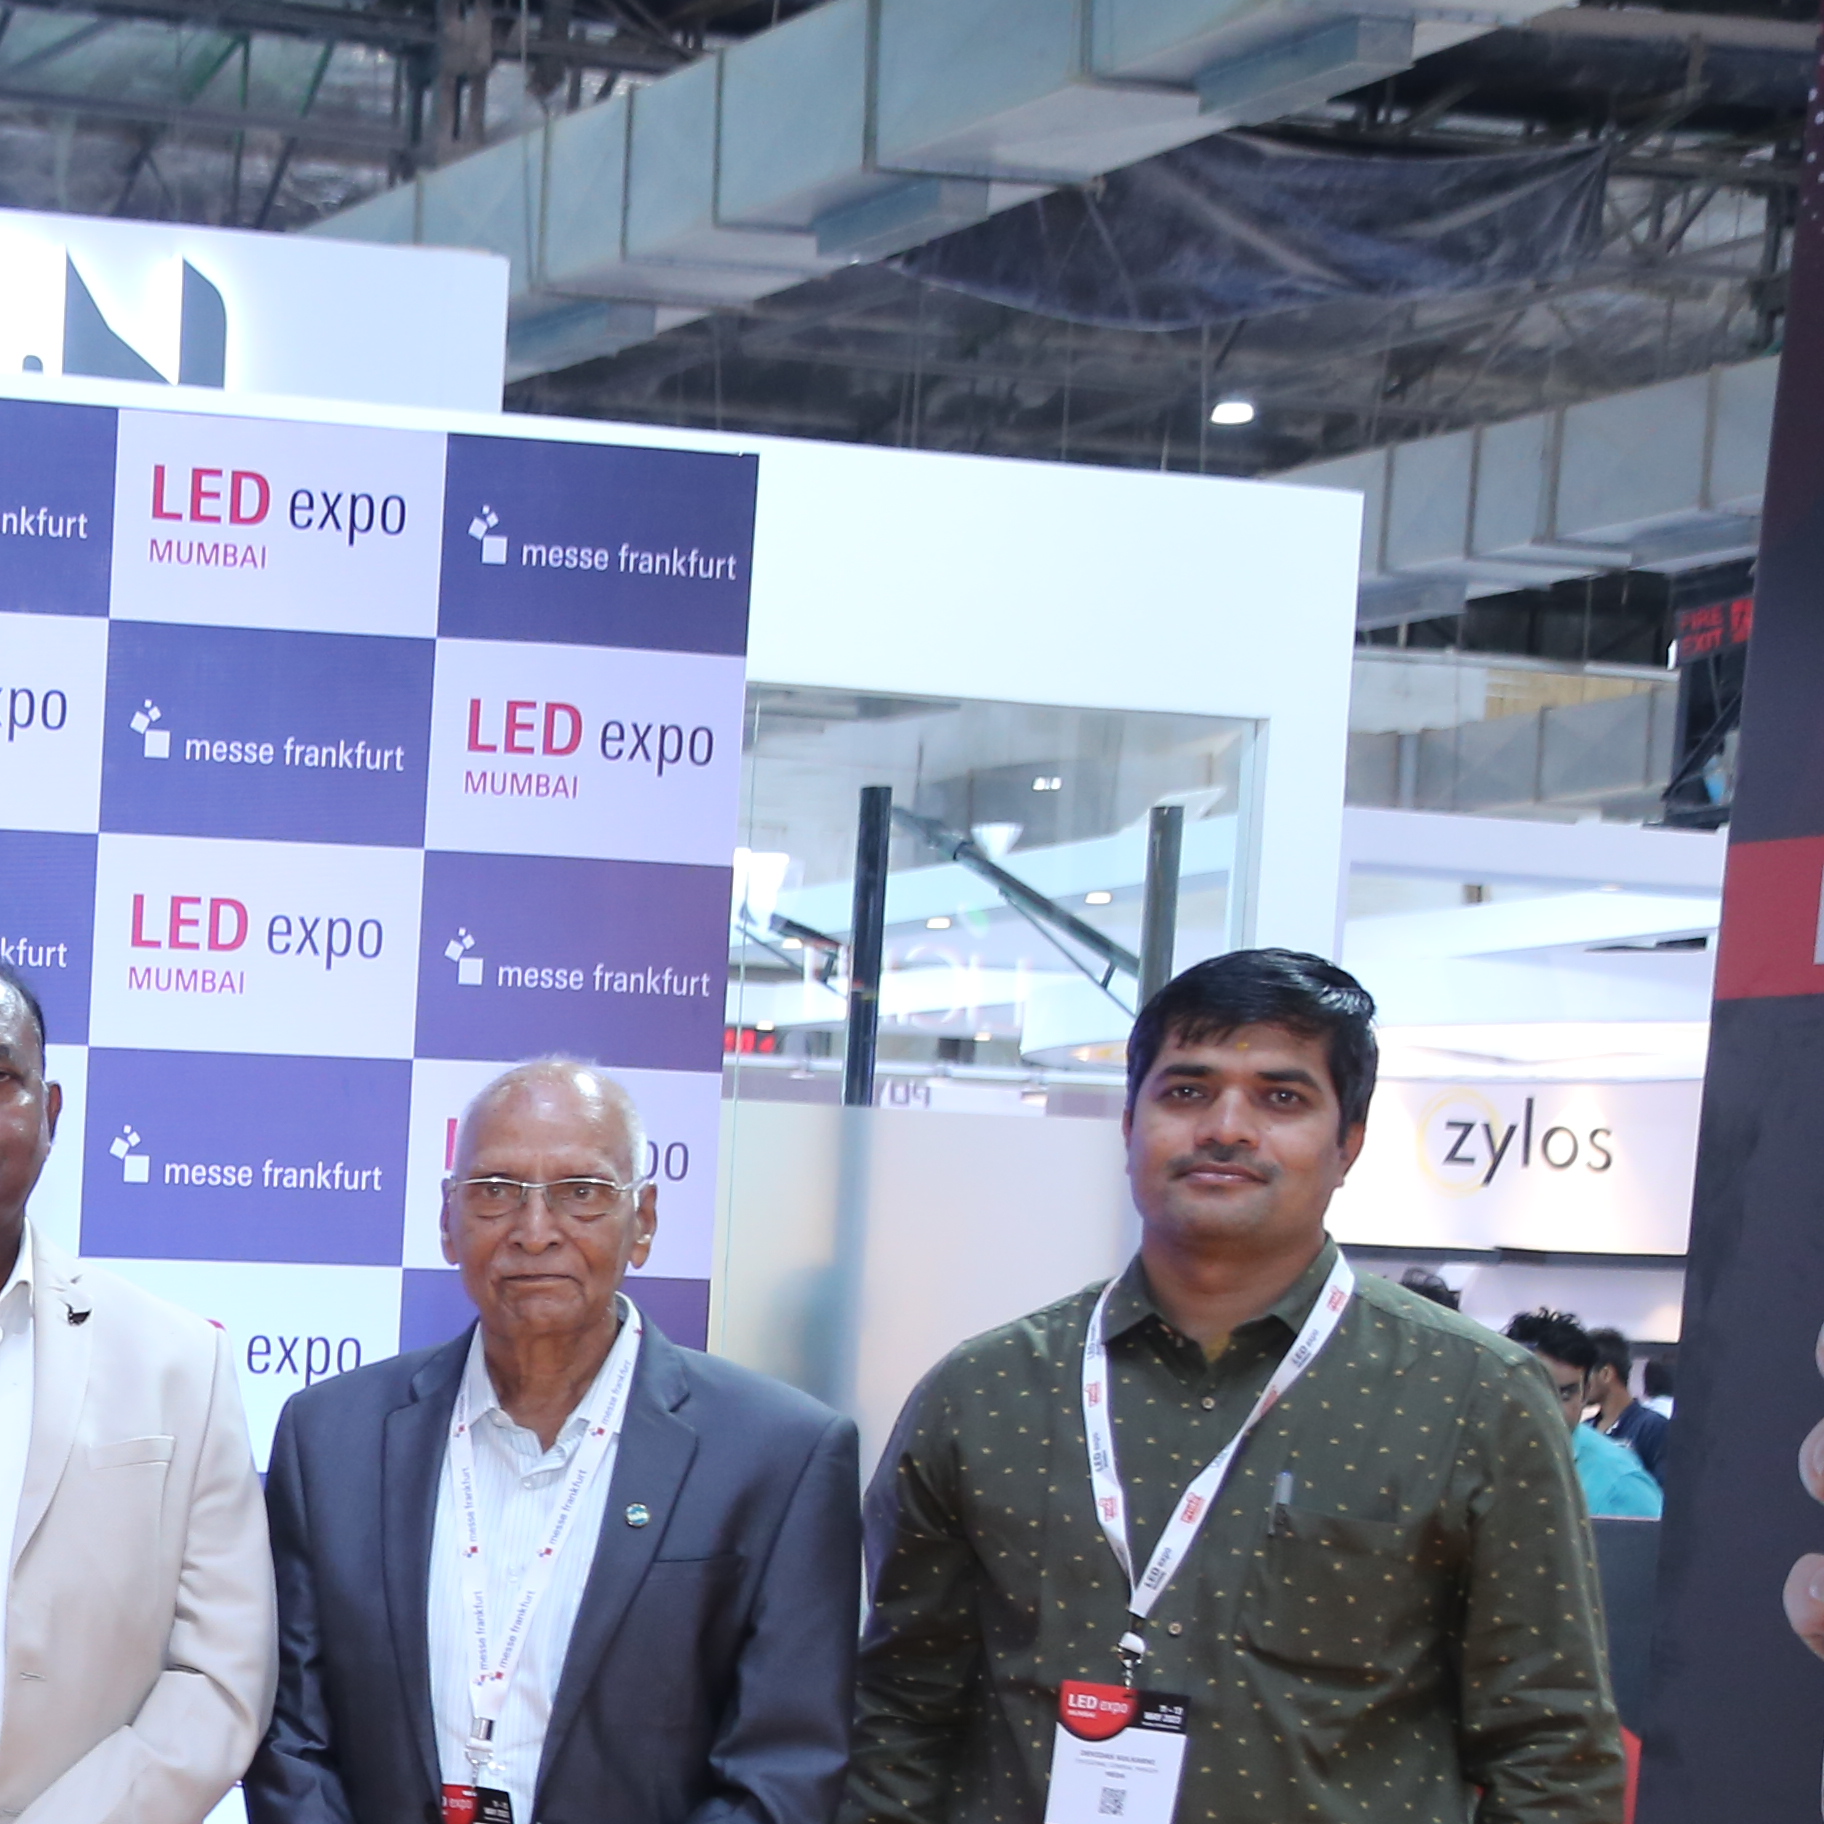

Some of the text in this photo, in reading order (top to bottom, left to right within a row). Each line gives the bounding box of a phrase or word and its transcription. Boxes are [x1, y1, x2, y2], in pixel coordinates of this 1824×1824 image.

[152, 465, 405, 546] LED expo
[150, 538, 266, 569] MUMBAI
[522, 543, 736, 580] messe frankfurt
[186, 737, 404, 771] messe frankfurt
[468, 699, 713, 777] LED expo
[465, 770, 577, 799] MUMBAI
[131, 894, 383, 970] LED expo
[129, 966, 244, 994] MUMBAI
[498, 963, 710, 996] messe frankfurt
[1442, 1096, 1613, 1188] zylos
[165, 1159, 382, 1190] messe frankfurt
[247, 1334, 362, 1386] expo
[611, 1358, 632, 1400] frankfurt
[462, 1465, 476, 1543] messe frankfurt
[548, 1468, 588, 1545] messe frankfurt
[473, 1589, 484, 1639] frankfurt
[499, 1589, 535, 1669] messe frankfurt
[1067, 1693, 1128, 1715] LED expo
